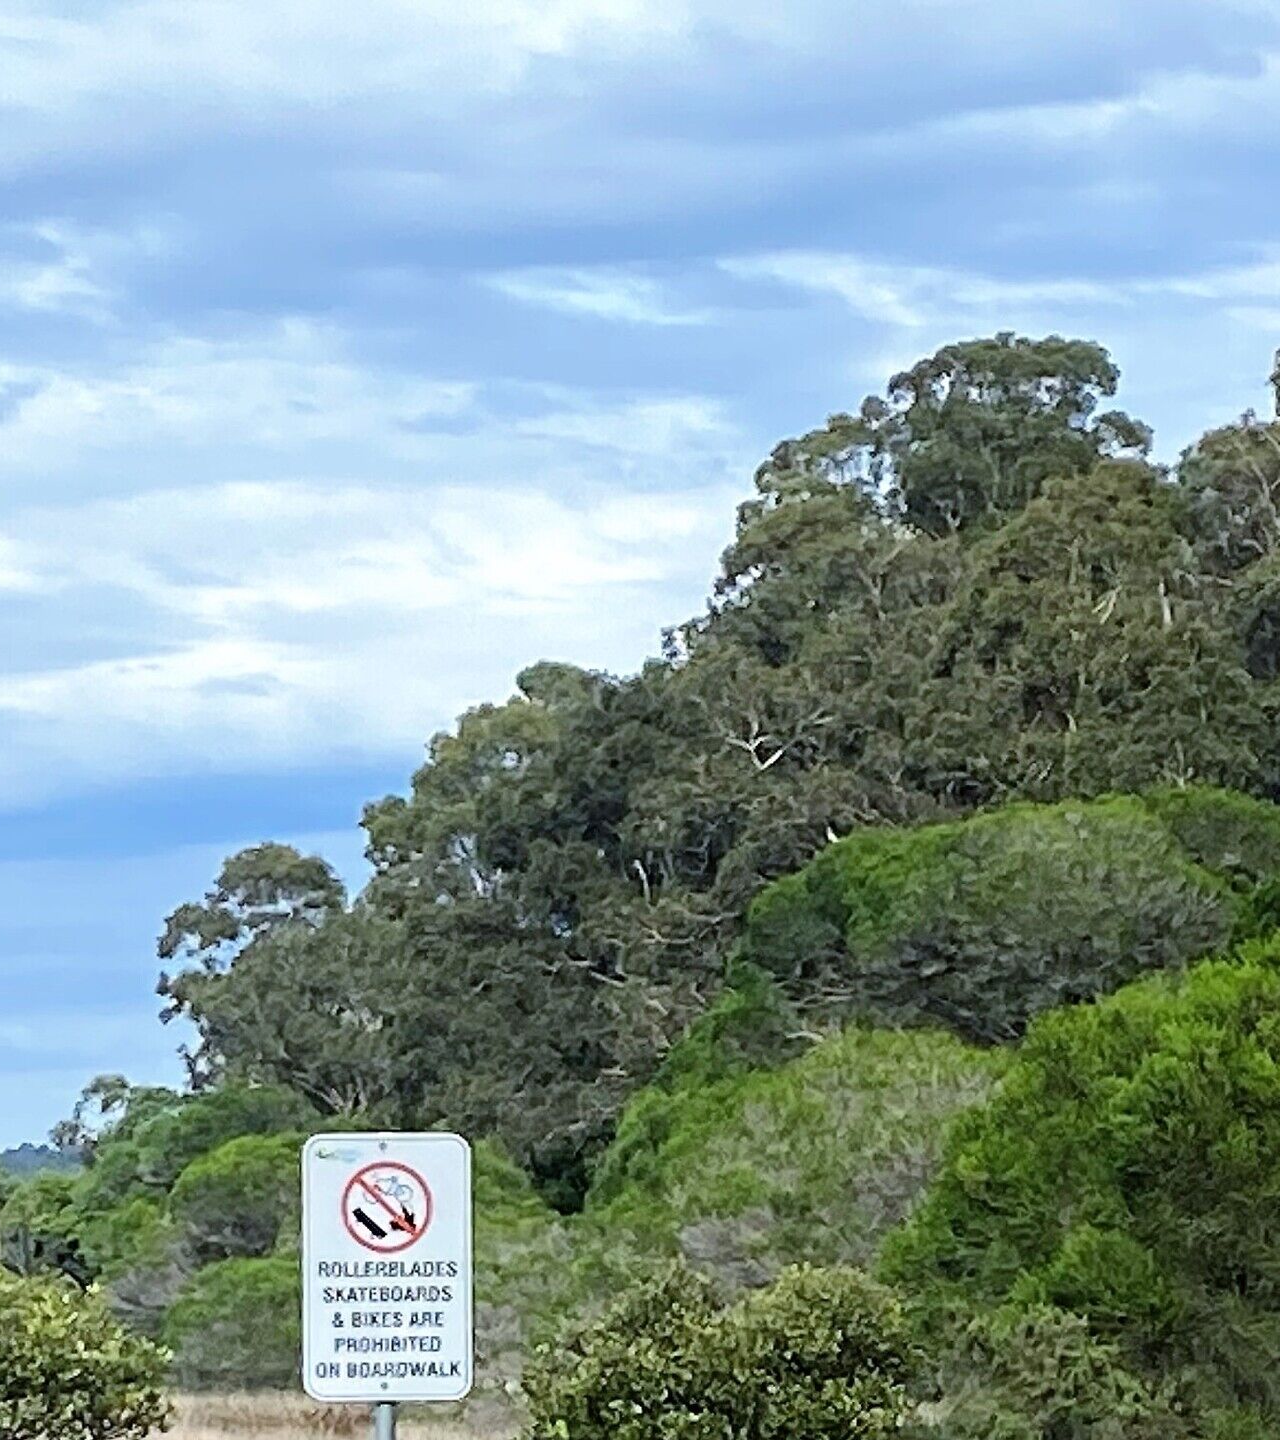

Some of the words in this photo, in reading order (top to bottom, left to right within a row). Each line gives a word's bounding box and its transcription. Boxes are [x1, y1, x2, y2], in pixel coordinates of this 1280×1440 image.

[318, 1261, 458, 1278] ROLLERBLADES
[322, 1286, 453, 1303] SKATEBOARDS
[332, 1312, 344, 1328] &
[351, 1312, 403, 1328] BIKES
[409, 1311, 444, 1328] ARE
[334, 1336, 442, 1353] PROHIBITED
[315, 1362, 340, 1378] ON
[347, 1361, 461, 1379] BOARDWALK
